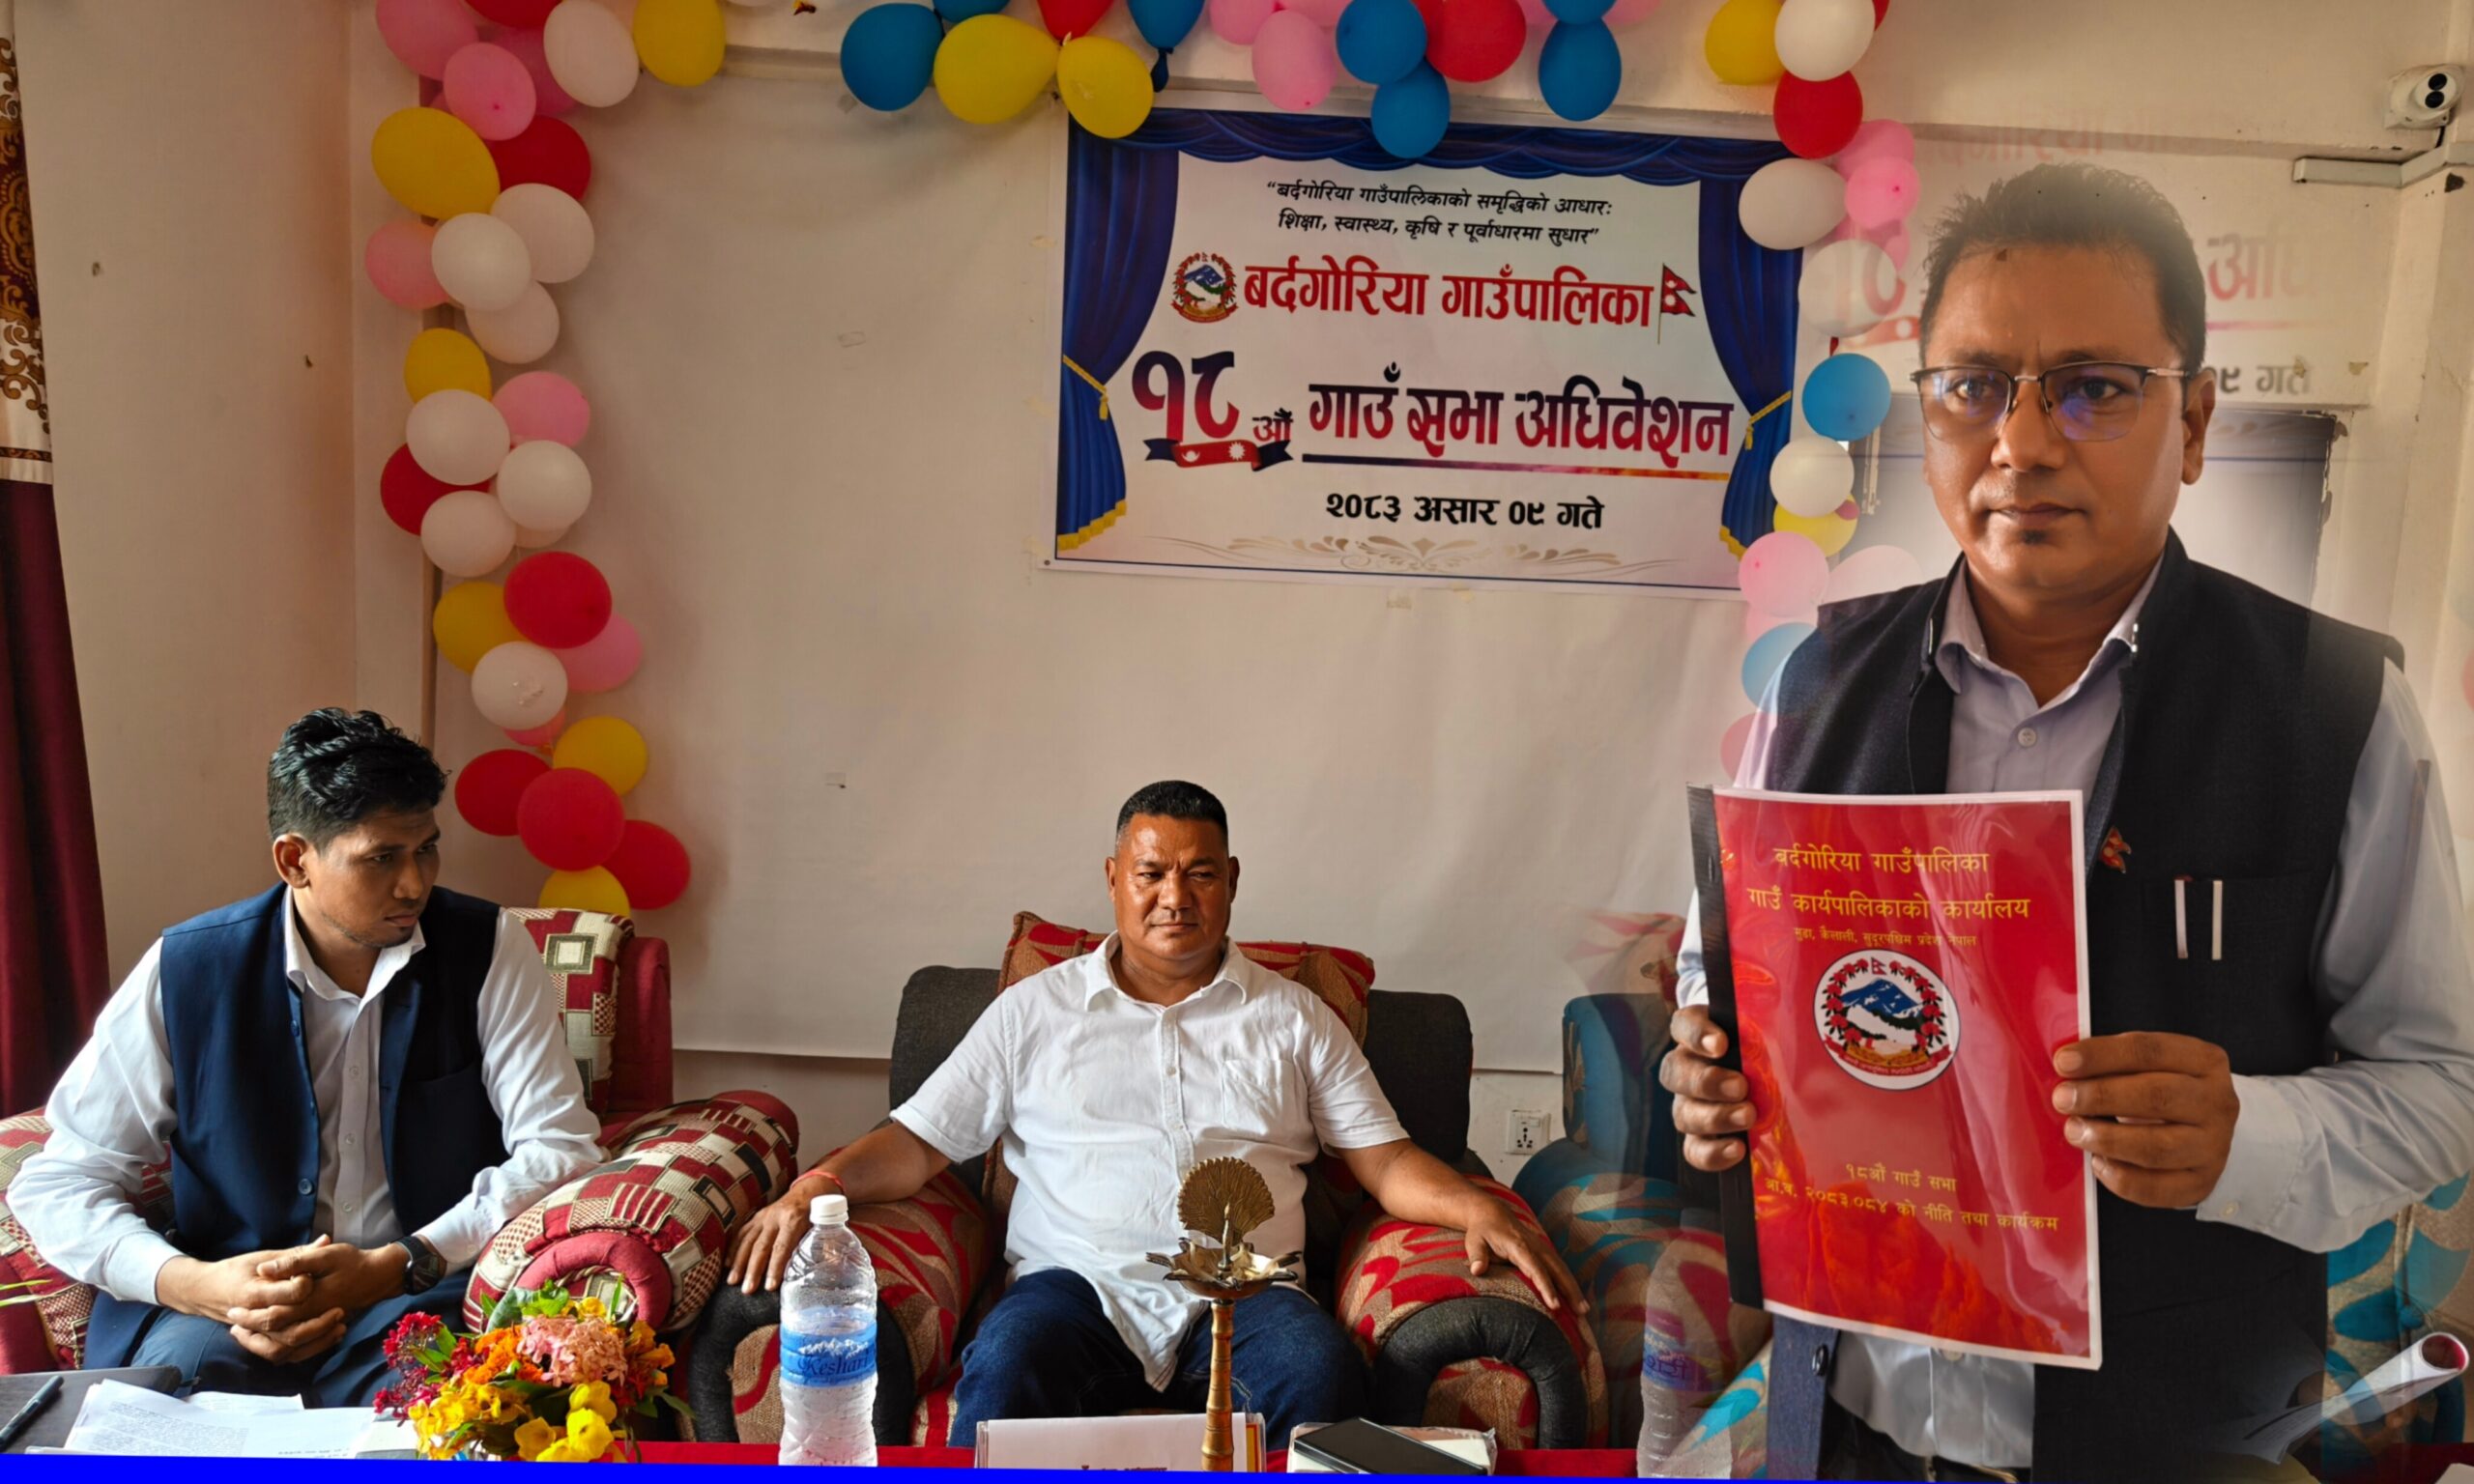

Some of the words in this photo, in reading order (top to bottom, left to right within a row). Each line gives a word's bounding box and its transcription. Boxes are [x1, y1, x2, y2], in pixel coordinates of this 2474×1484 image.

[1267, 180, 1354, 201] “बर्दगोरिया
[1359, 184, 1472, 207] गाउँपालिकाको
[1477, 189, 1549, 214] समृद्धिको
[1279, 208, 1327, 231] शिक्षा,
[1335, 216, 1397, 235] स्वास्थ्य,
[1405, 215, 1442, 240] कृषि
[1448, 222, 1459, 237] र
[1464, 219, 1542, 243] पूर्वाधारमा
[1548, 227, 1598, 246] सुधार”
[1244, 255, 1429, 315] बर्दगोरिया
[1442, 264, 1654, 327] गाउँपालिका
[1309, 361, 1399, 440] गाउँ
[1406, 387, 1505, 458] सभा
[1514, 375, 1734, 469] अधिवेशन
[1326, 493, 1401, 523] २०८३
[1414, 496, 1500, 527] असार
[1509, 500, 1544, 526] ०९
[1557, 495, 1604, 528] गते
[1773, 842, 1861, 871] बर्दगोरिया
[1871, 846, 1989, 873] गाउँपालिका
[1747, 885, 1782, 910] गाउँ
[1791, 890, 1932, 919] कार्यपालिकाको
[1941, 893, 2030, 919] कार्यालय
[1892, 1170, 1921, 1188] गाउँ
[1929, 1175, 1957, 1192] सभा
[1895, 1199, 1916, 1217] को
[1923, 1204, 1953, 1222] नीति
[1962, 1212, 1989, 1227] तथा
[1996, 1211, 2059, 1232] कार्यक्रम
